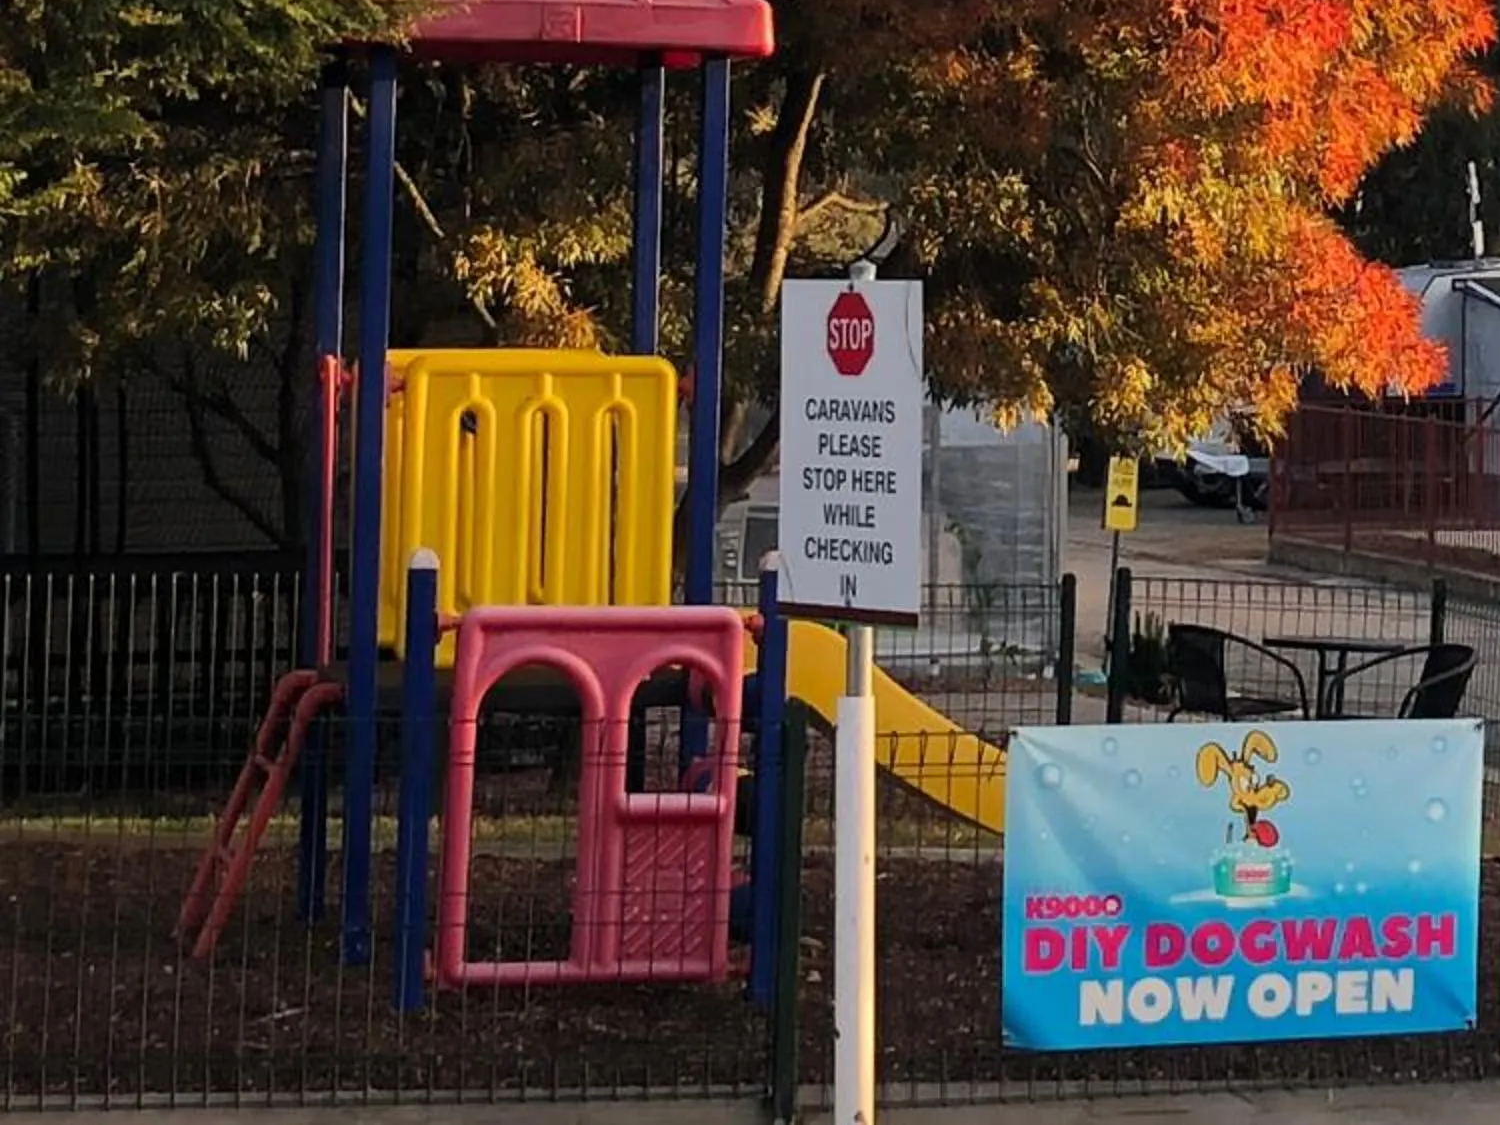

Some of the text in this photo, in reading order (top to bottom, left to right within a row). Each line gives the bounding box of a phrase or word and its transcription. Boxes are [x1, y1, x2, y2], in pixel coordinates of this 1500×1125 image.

[829, 318, 873, 351] STOP
[805, 398, 895, 423] CARAVANS
[818, 434, 881, 458] PLEASE
[802, 468, 896, 494] STOP HERE
[823, 504, 875, 528] WHILE
[805, 538, 893, 565] CHECKING
[840, 574, 857, 598] IN
[1024, 914, 1456, 972] DIY DOGWASH
[1078, 968, 1415, 1027] NOW OPEN
